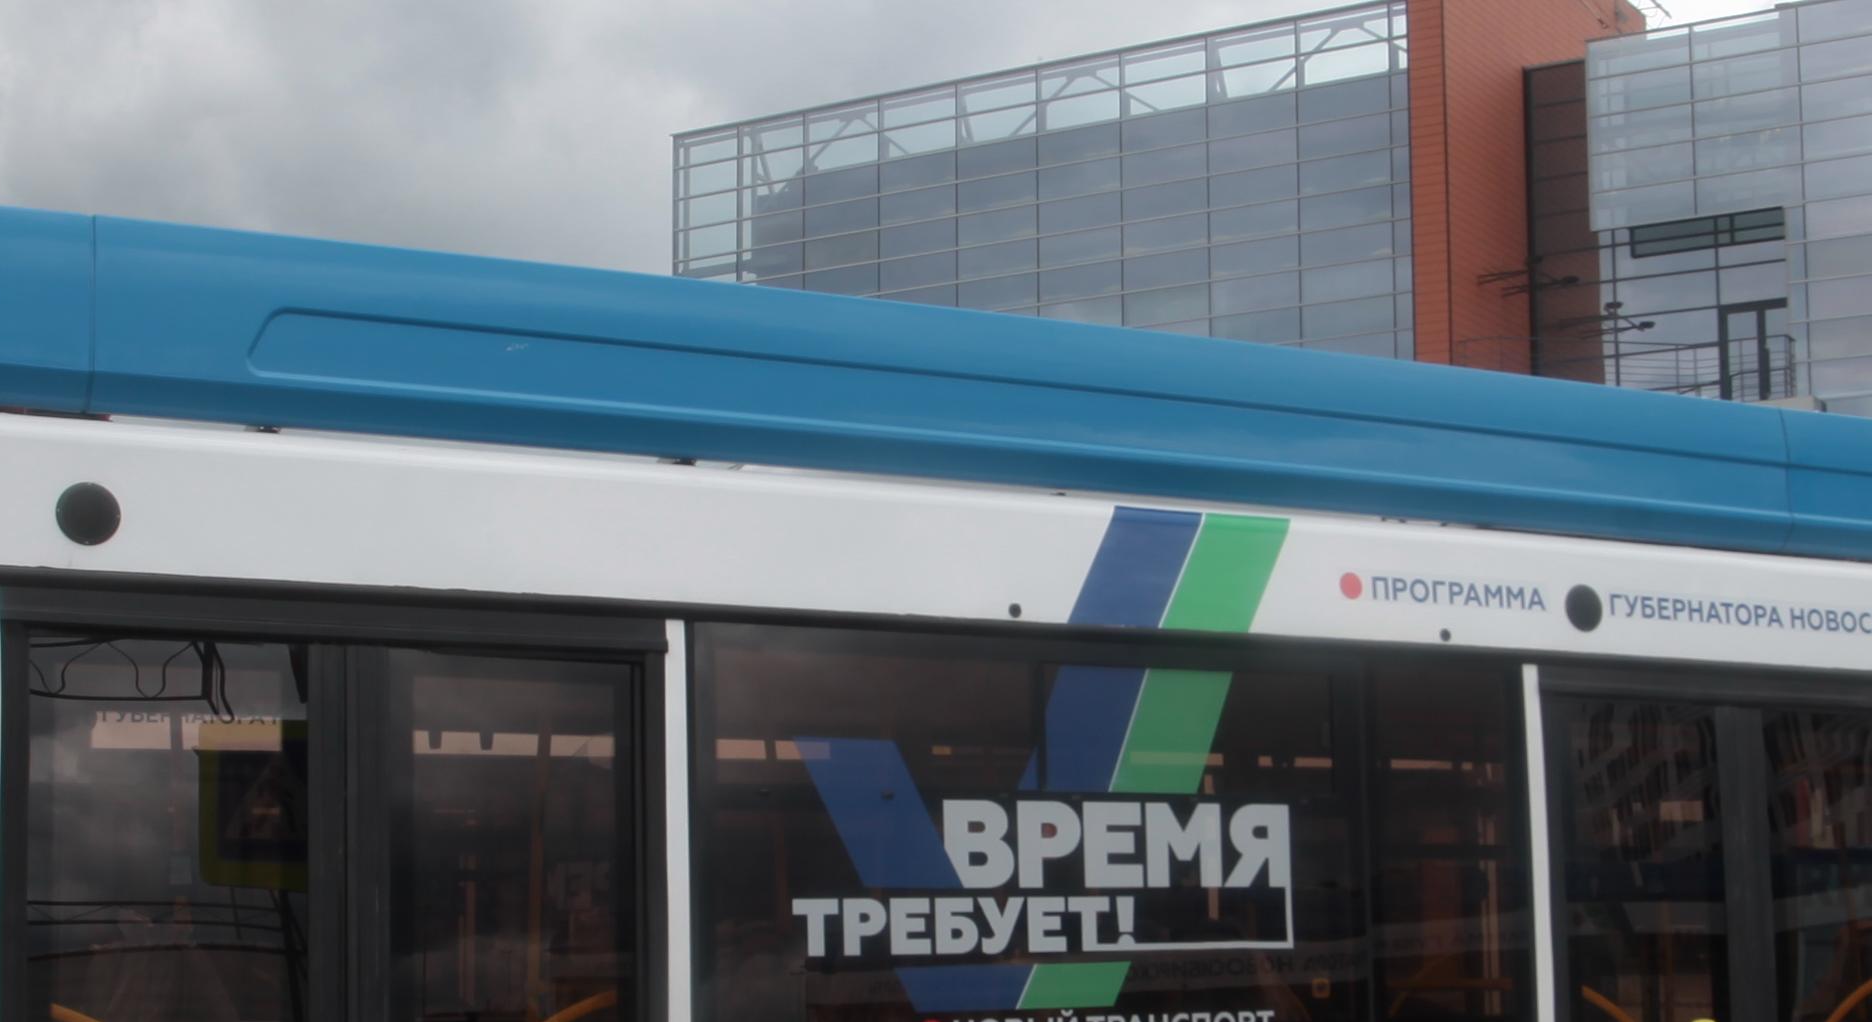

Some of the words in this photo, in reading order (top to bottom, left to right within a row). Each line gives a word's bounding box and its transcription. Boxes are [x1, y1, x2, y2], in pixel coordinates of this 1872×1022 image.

[1371, 576, 1547, 611] ПРОГРАММА
[1608, 594, 1785, 628] ГУБЕРНАТОРА
[943, 799, 1291, 888] ВРЕМЯ
[792, 895, 1136, 956] ТРЕБУЕТ!
